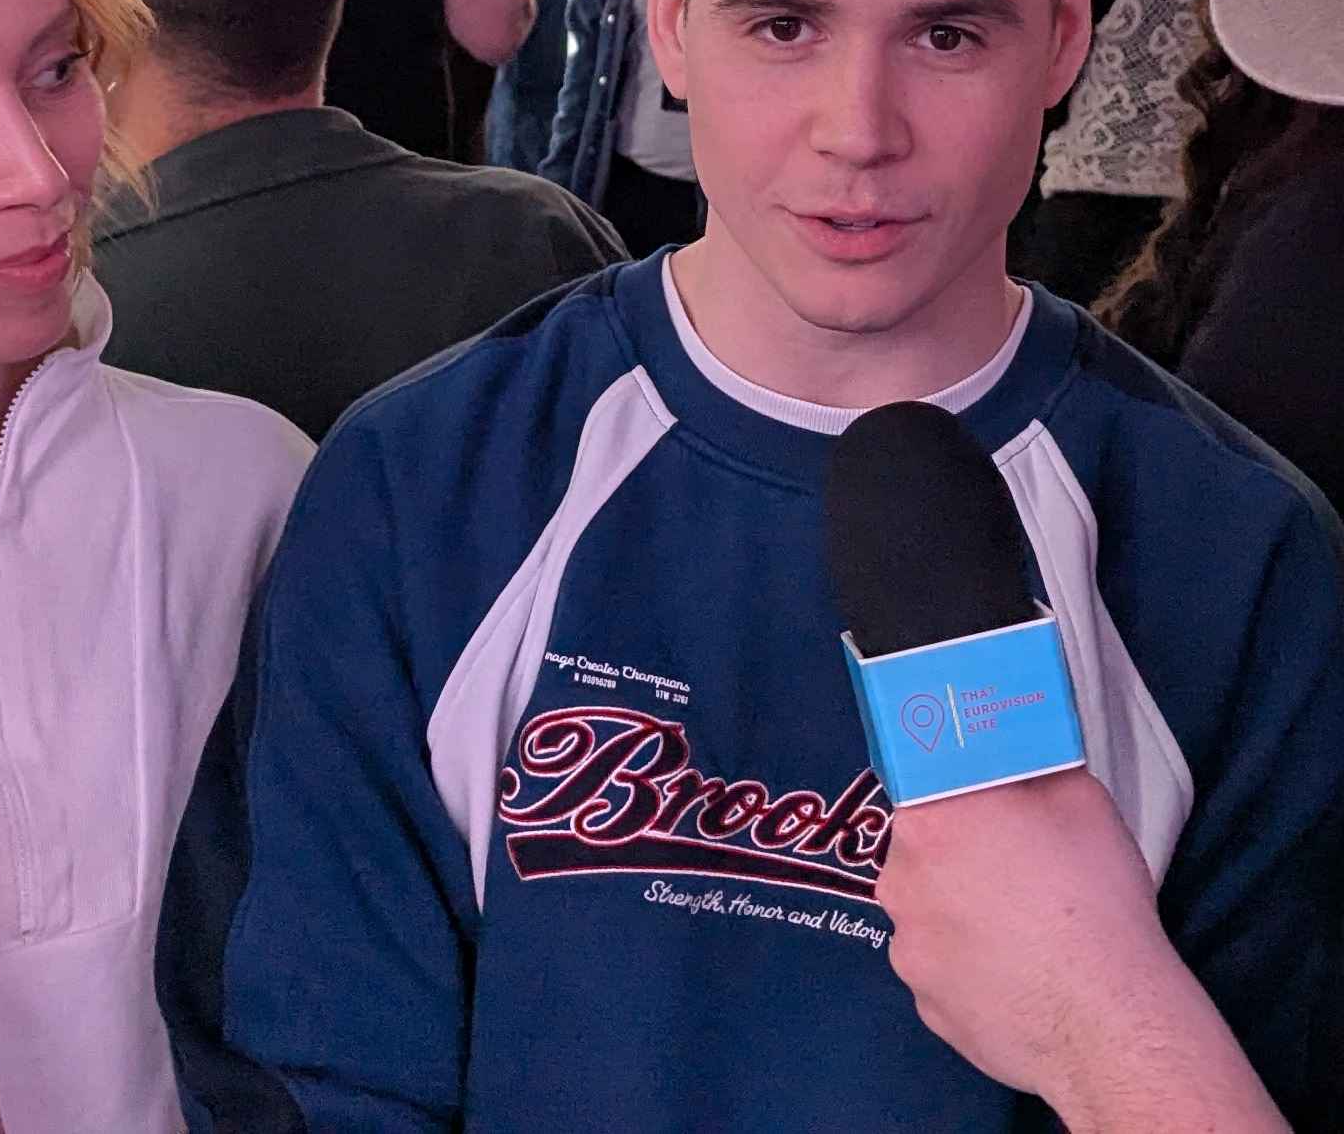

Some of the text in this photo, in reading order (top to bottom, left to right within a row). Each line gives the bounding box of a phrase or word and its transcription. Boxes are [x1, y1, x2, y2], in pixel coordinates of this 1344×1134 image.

[577, 656, 620, 677] Creates
[622, 666, 691, 692] Champions
[961, 686, 996, 702] THAT
[964, 691, 1045, 718] EUROVISION
[967, 719, 997, 733] SITE
[728, 893, 784, 920] Honor
[788, 909, 829, 930] and
[829, 909, 886, 949] Victory
